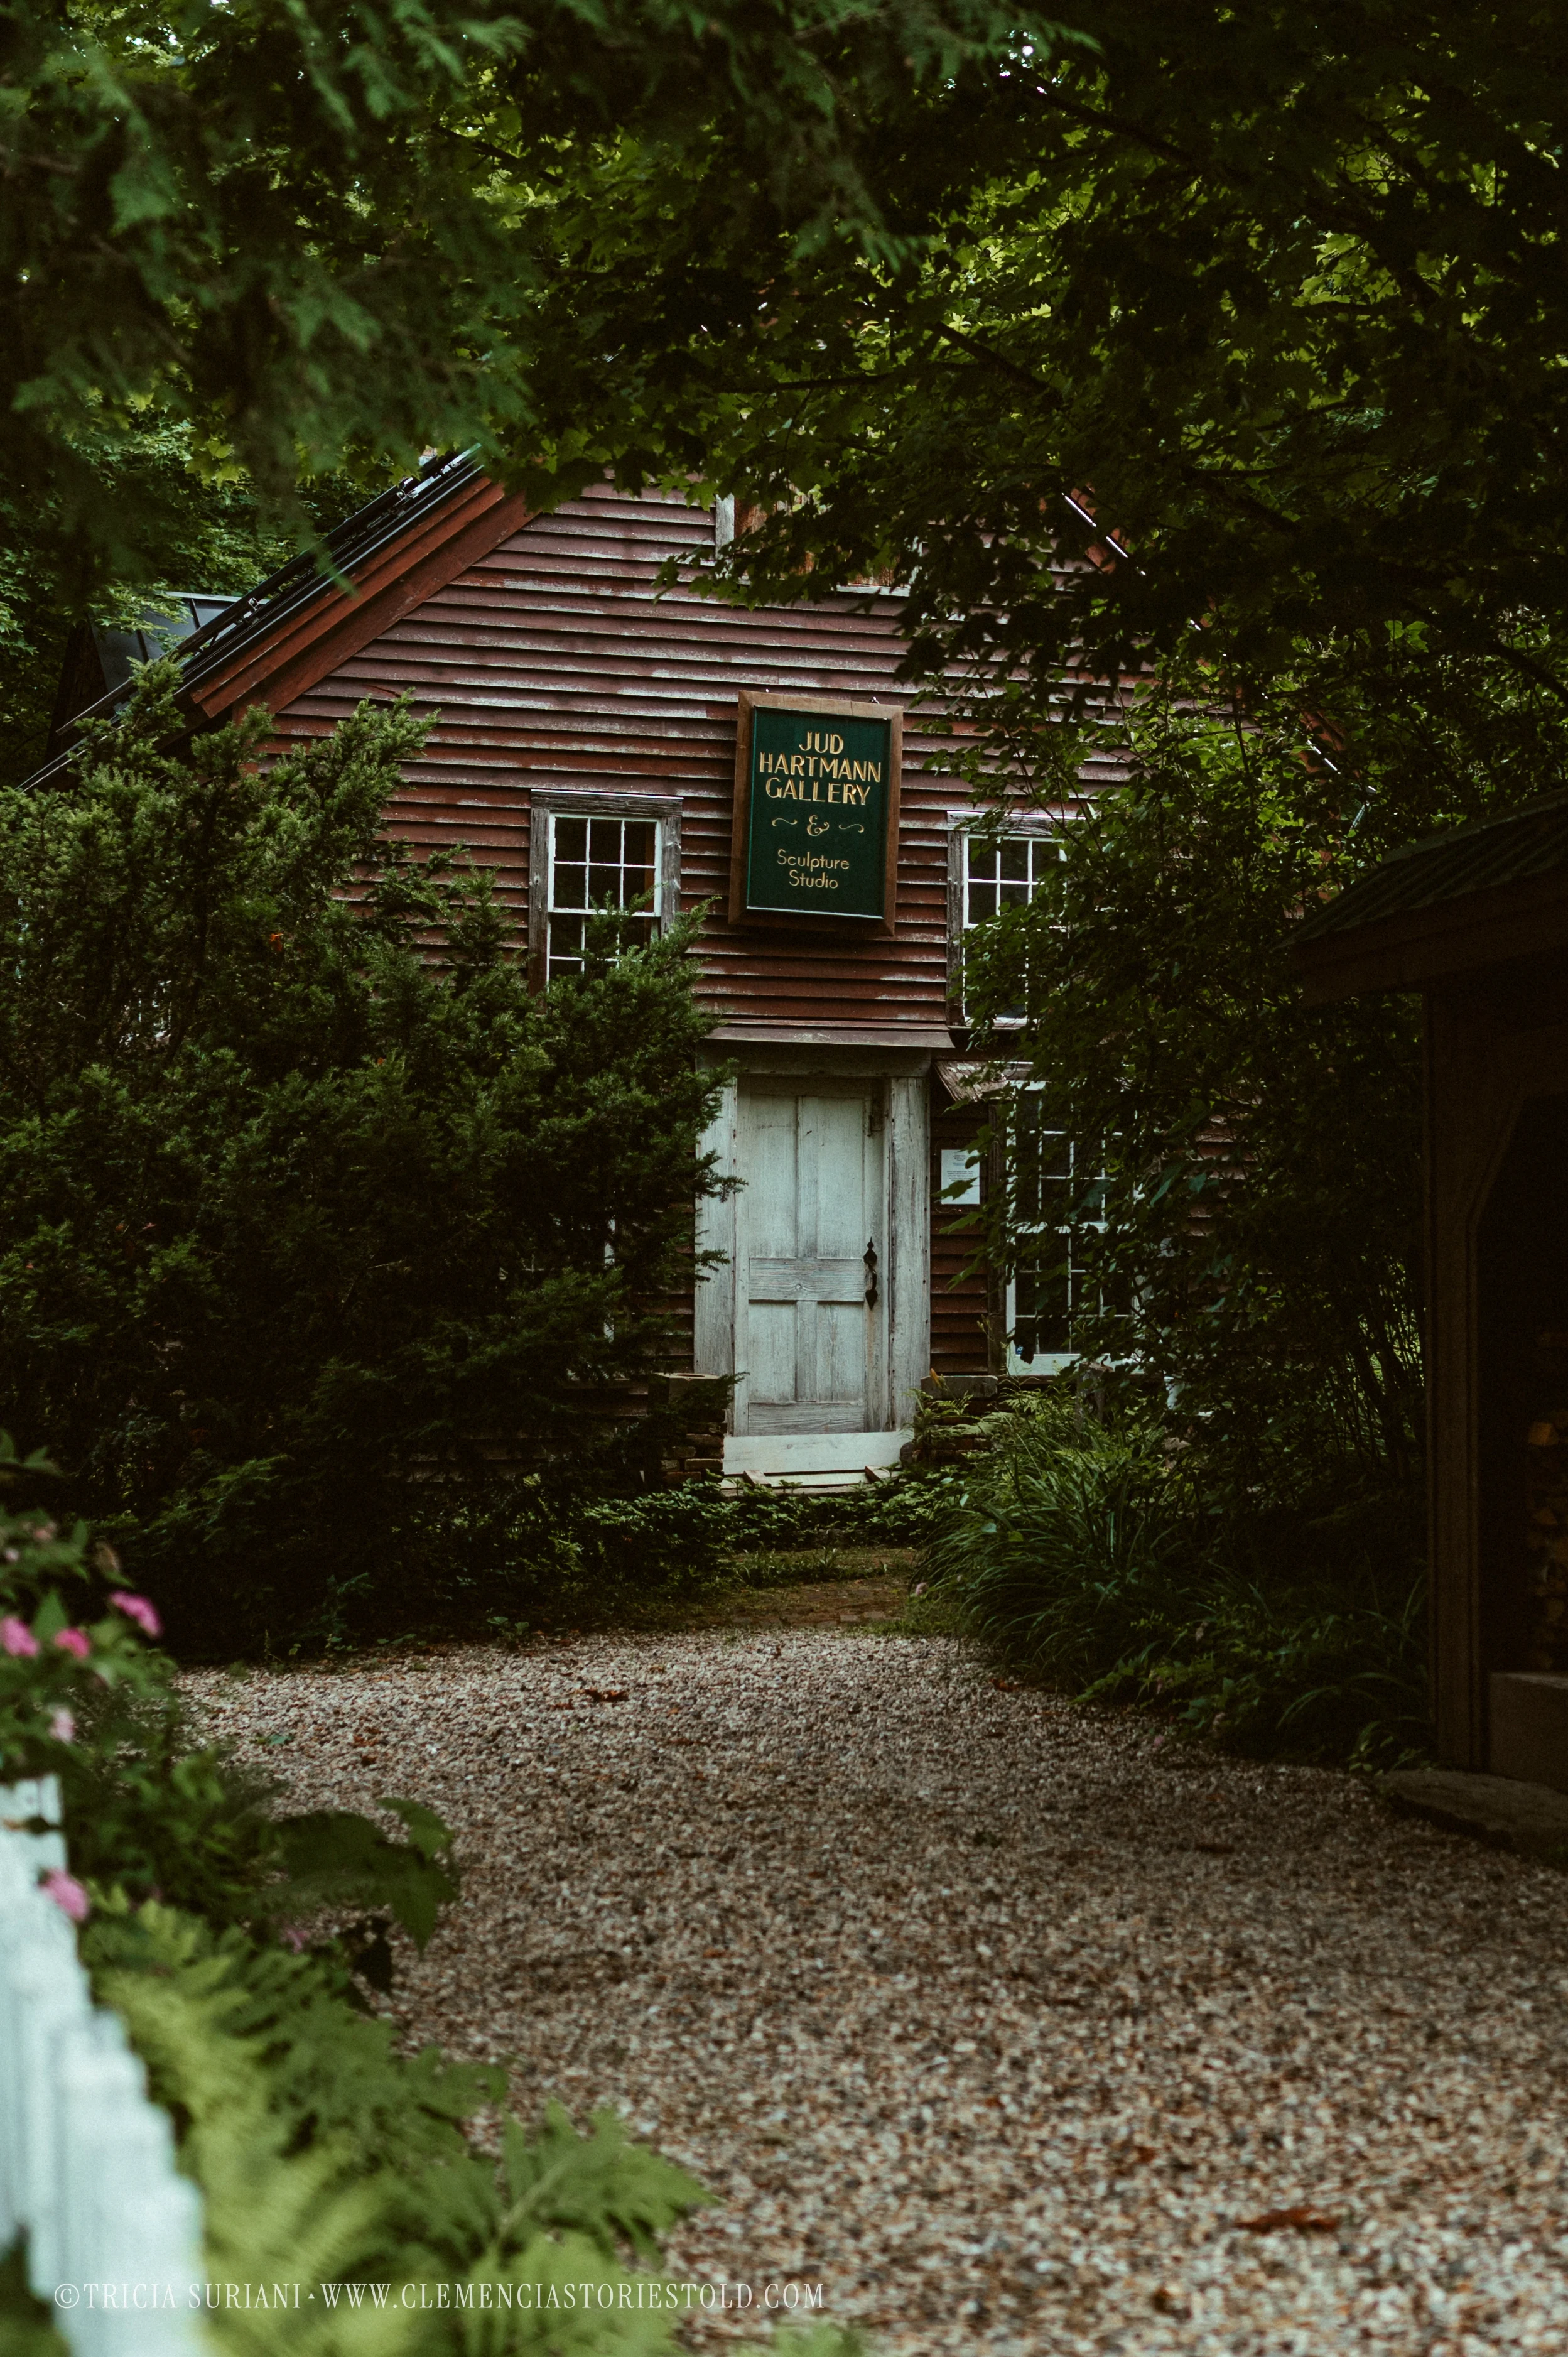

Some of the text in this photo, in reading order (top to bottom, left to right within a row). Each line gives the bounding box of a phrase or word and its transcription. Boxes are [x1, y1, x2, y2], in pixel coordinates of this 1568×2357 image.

[799, 731, 844, 754] JUD
[759, 752, 882, 783] HARTMANN
[765, 777, 871, 806] GALLERY
[806, 815, 830, 837] &
[777, 849, 850, 872] Sculpture
[789, 869, 838, 889] Studio
